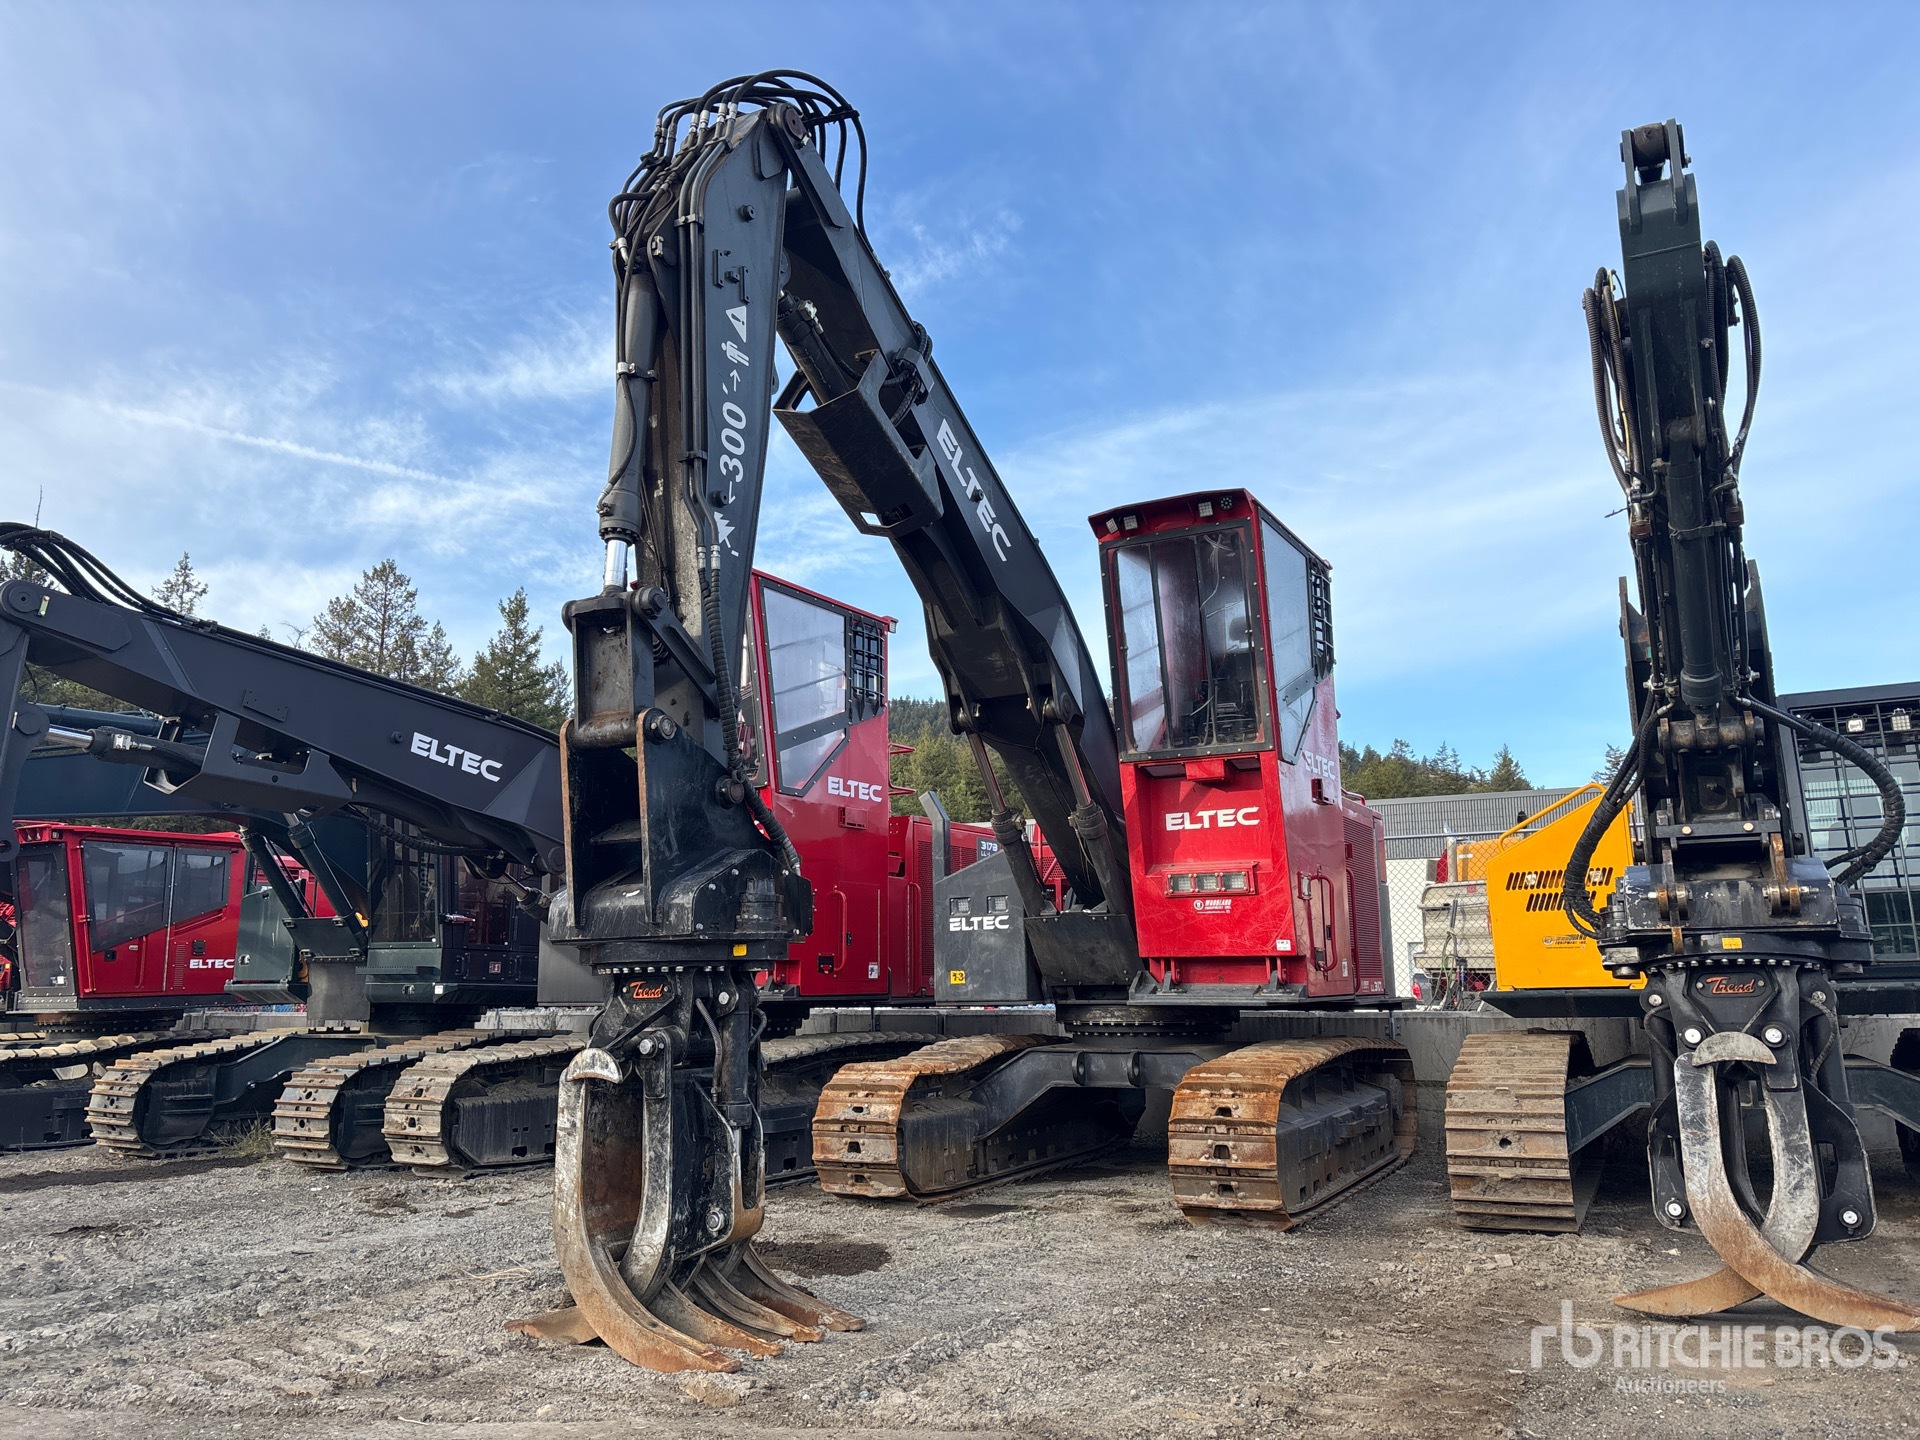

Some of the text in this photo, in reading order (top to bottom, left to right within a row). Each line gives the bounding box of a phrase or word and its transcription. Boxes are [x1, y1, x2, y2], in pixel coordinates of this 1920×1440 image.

[937, 418, 1012, 562] ELTEC
[410, 732, 503, 782] ELTEC
[1303, 750, 1336, 780] ELTEC
[828, 776, 882, 802] ELTEC
[1165, 807, 1260, 831] ELTEC
[949, 915, 1010, 932] ELTEC
[189, 959, 235, 969] ELTEC
